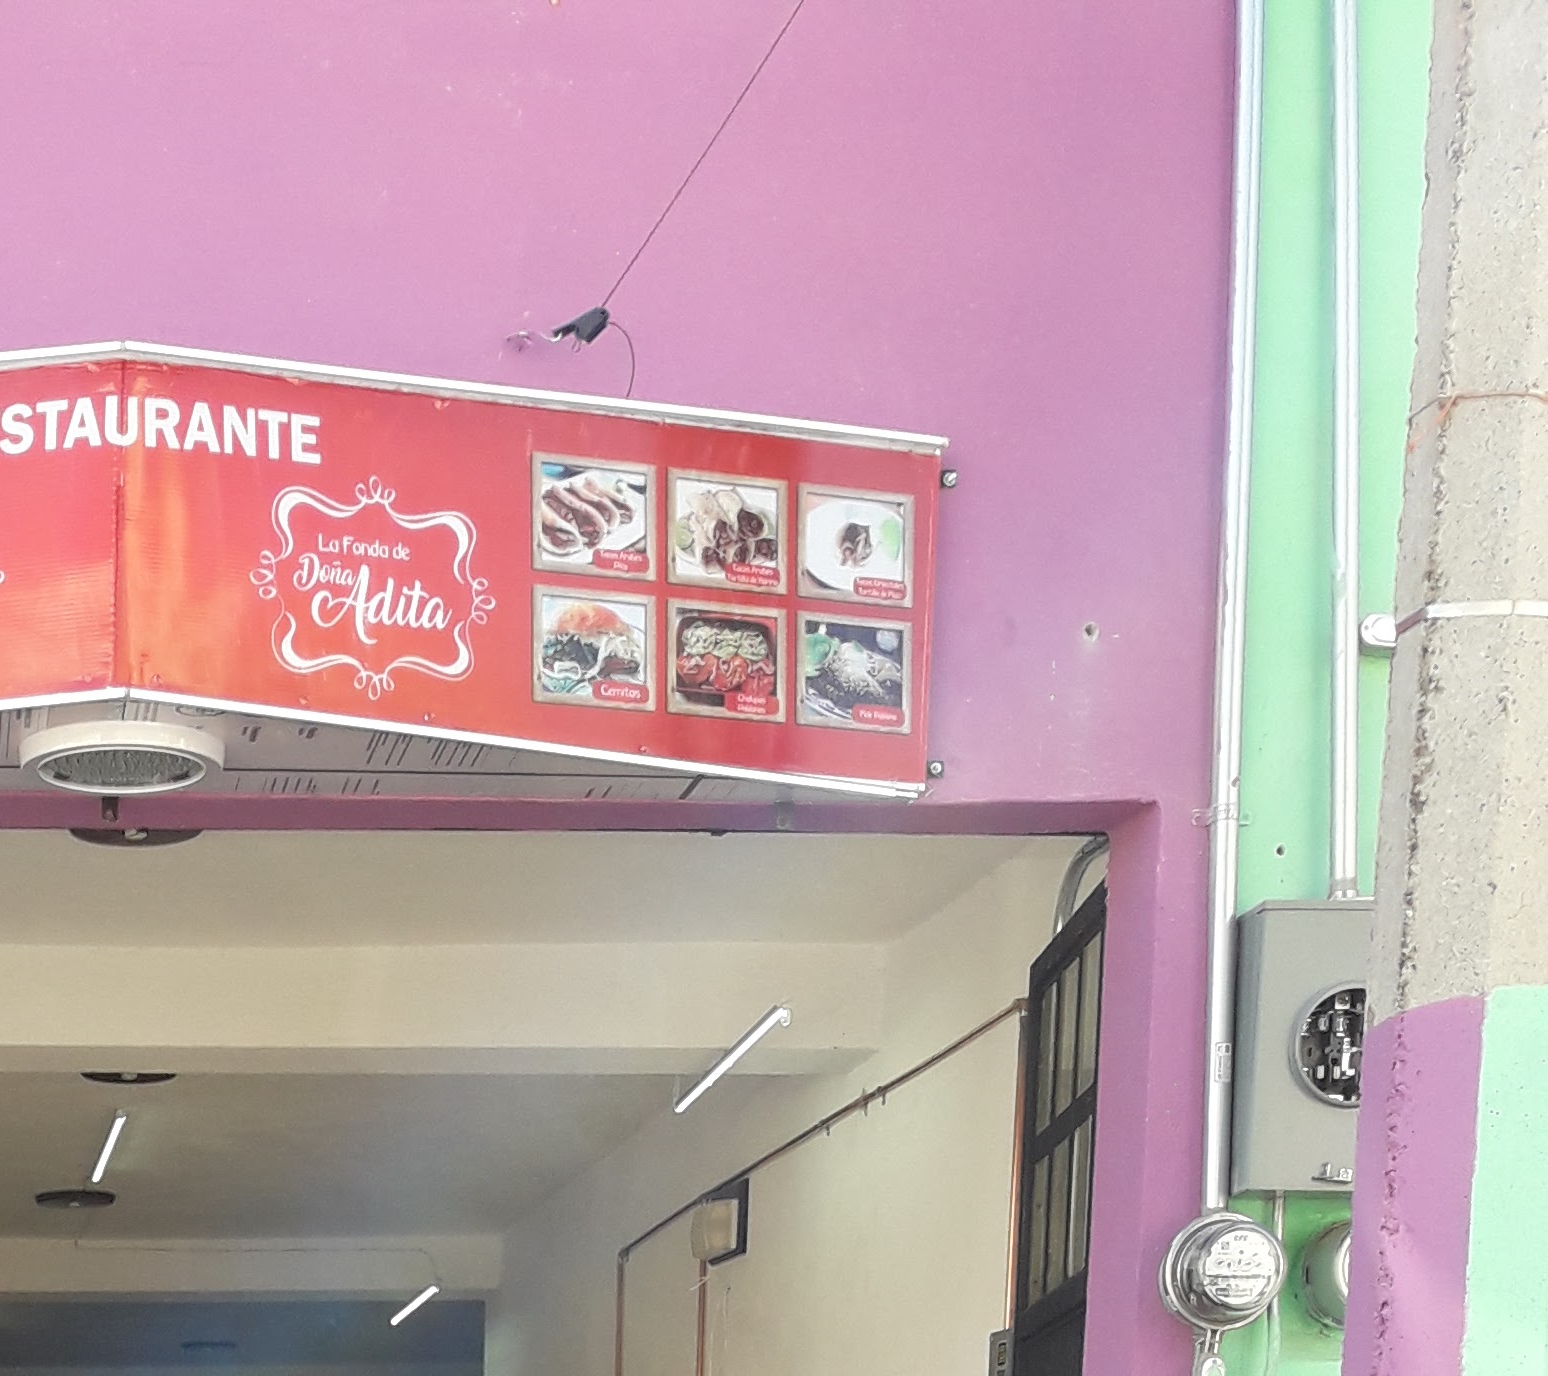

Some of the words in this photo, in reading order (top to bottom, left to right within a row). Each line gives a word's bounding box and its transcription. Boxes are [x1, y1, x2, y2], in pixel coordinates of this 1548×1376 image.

[318, 533, 339, 554] La
[343, 536, 389, 558] Fonda
[392, 541, 411, 561] de
[293, 553, 355, 589] Doña
[311, 564, 453, 645] Adita
